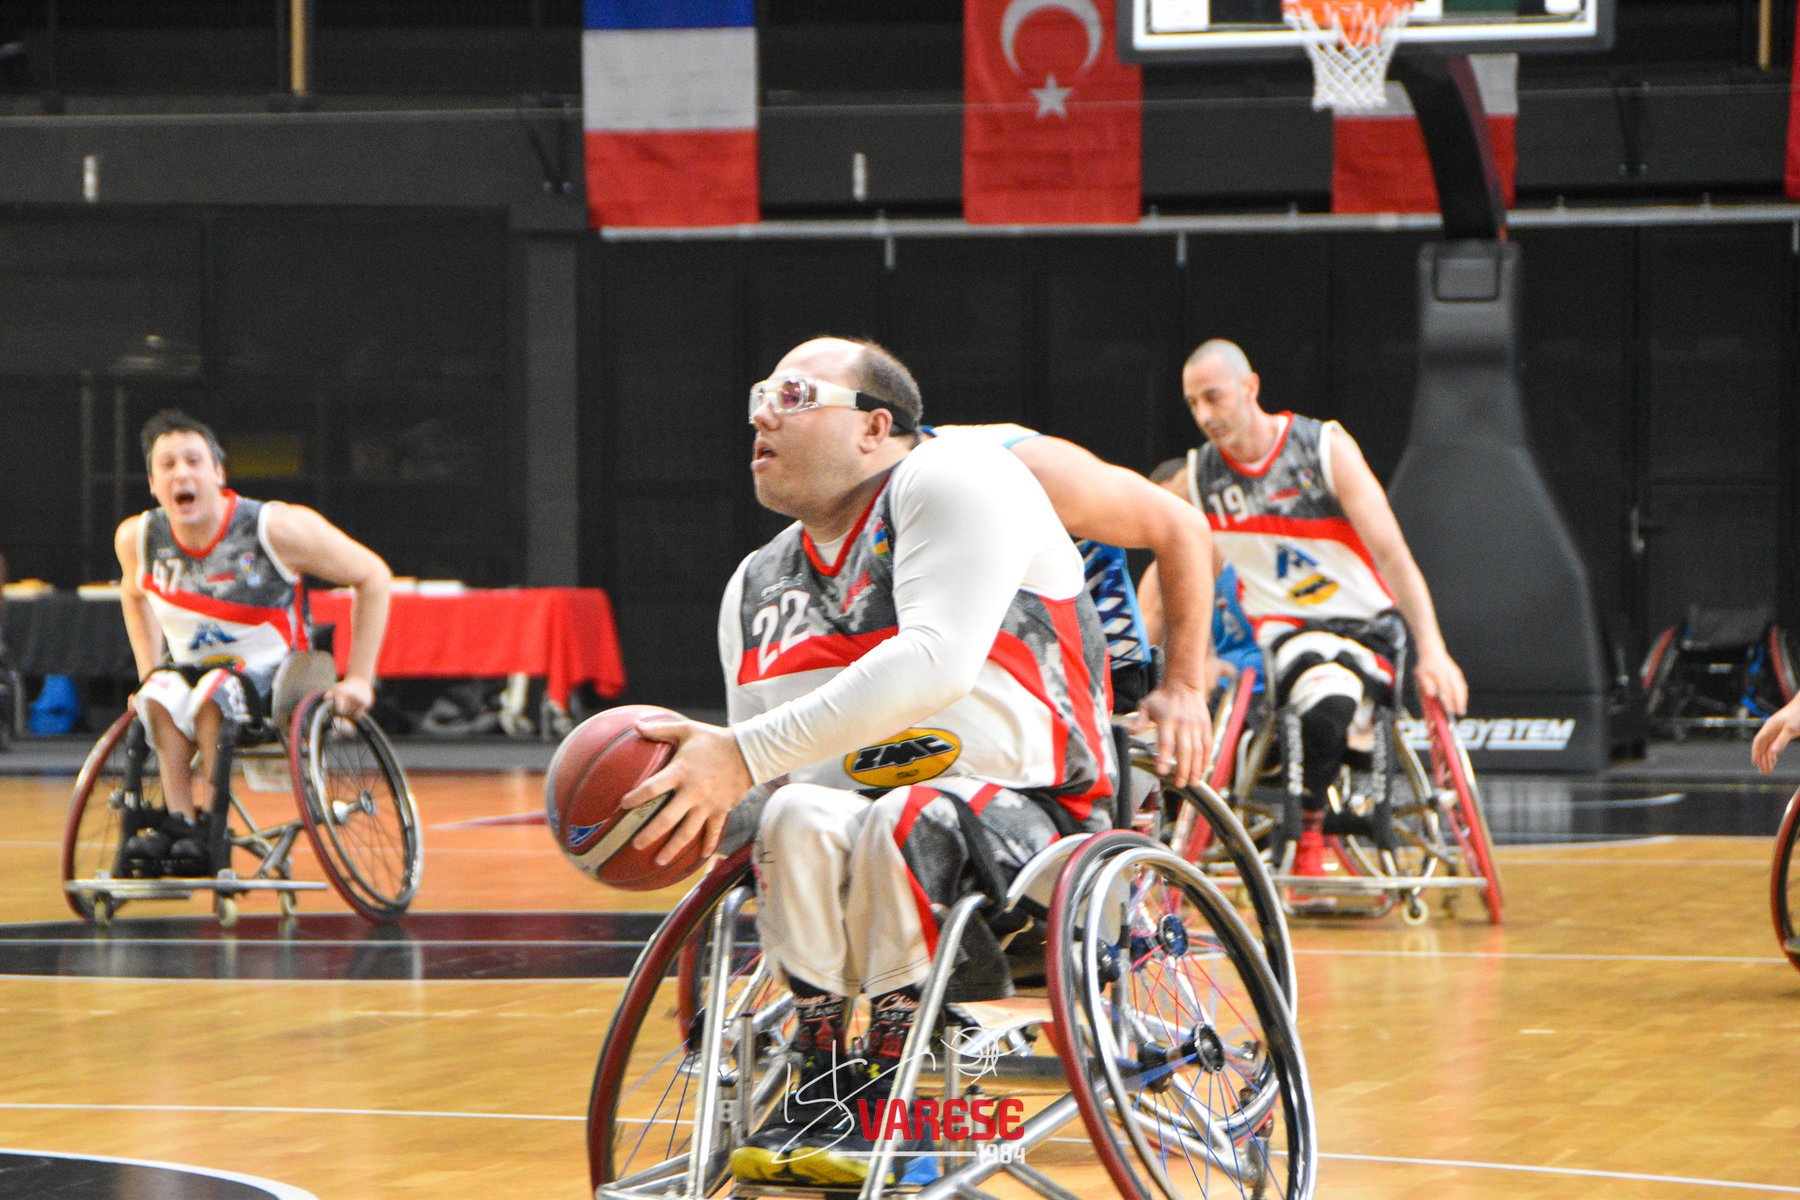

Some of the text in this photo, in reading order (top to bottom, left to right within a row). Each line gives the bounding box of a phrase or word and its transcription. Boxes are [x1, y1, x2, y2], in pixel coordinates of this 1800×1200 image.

[1207, 483, 1250, 528] 19
[152, 558, 183, 595] 47
[751, 589, 810, 676] 22
